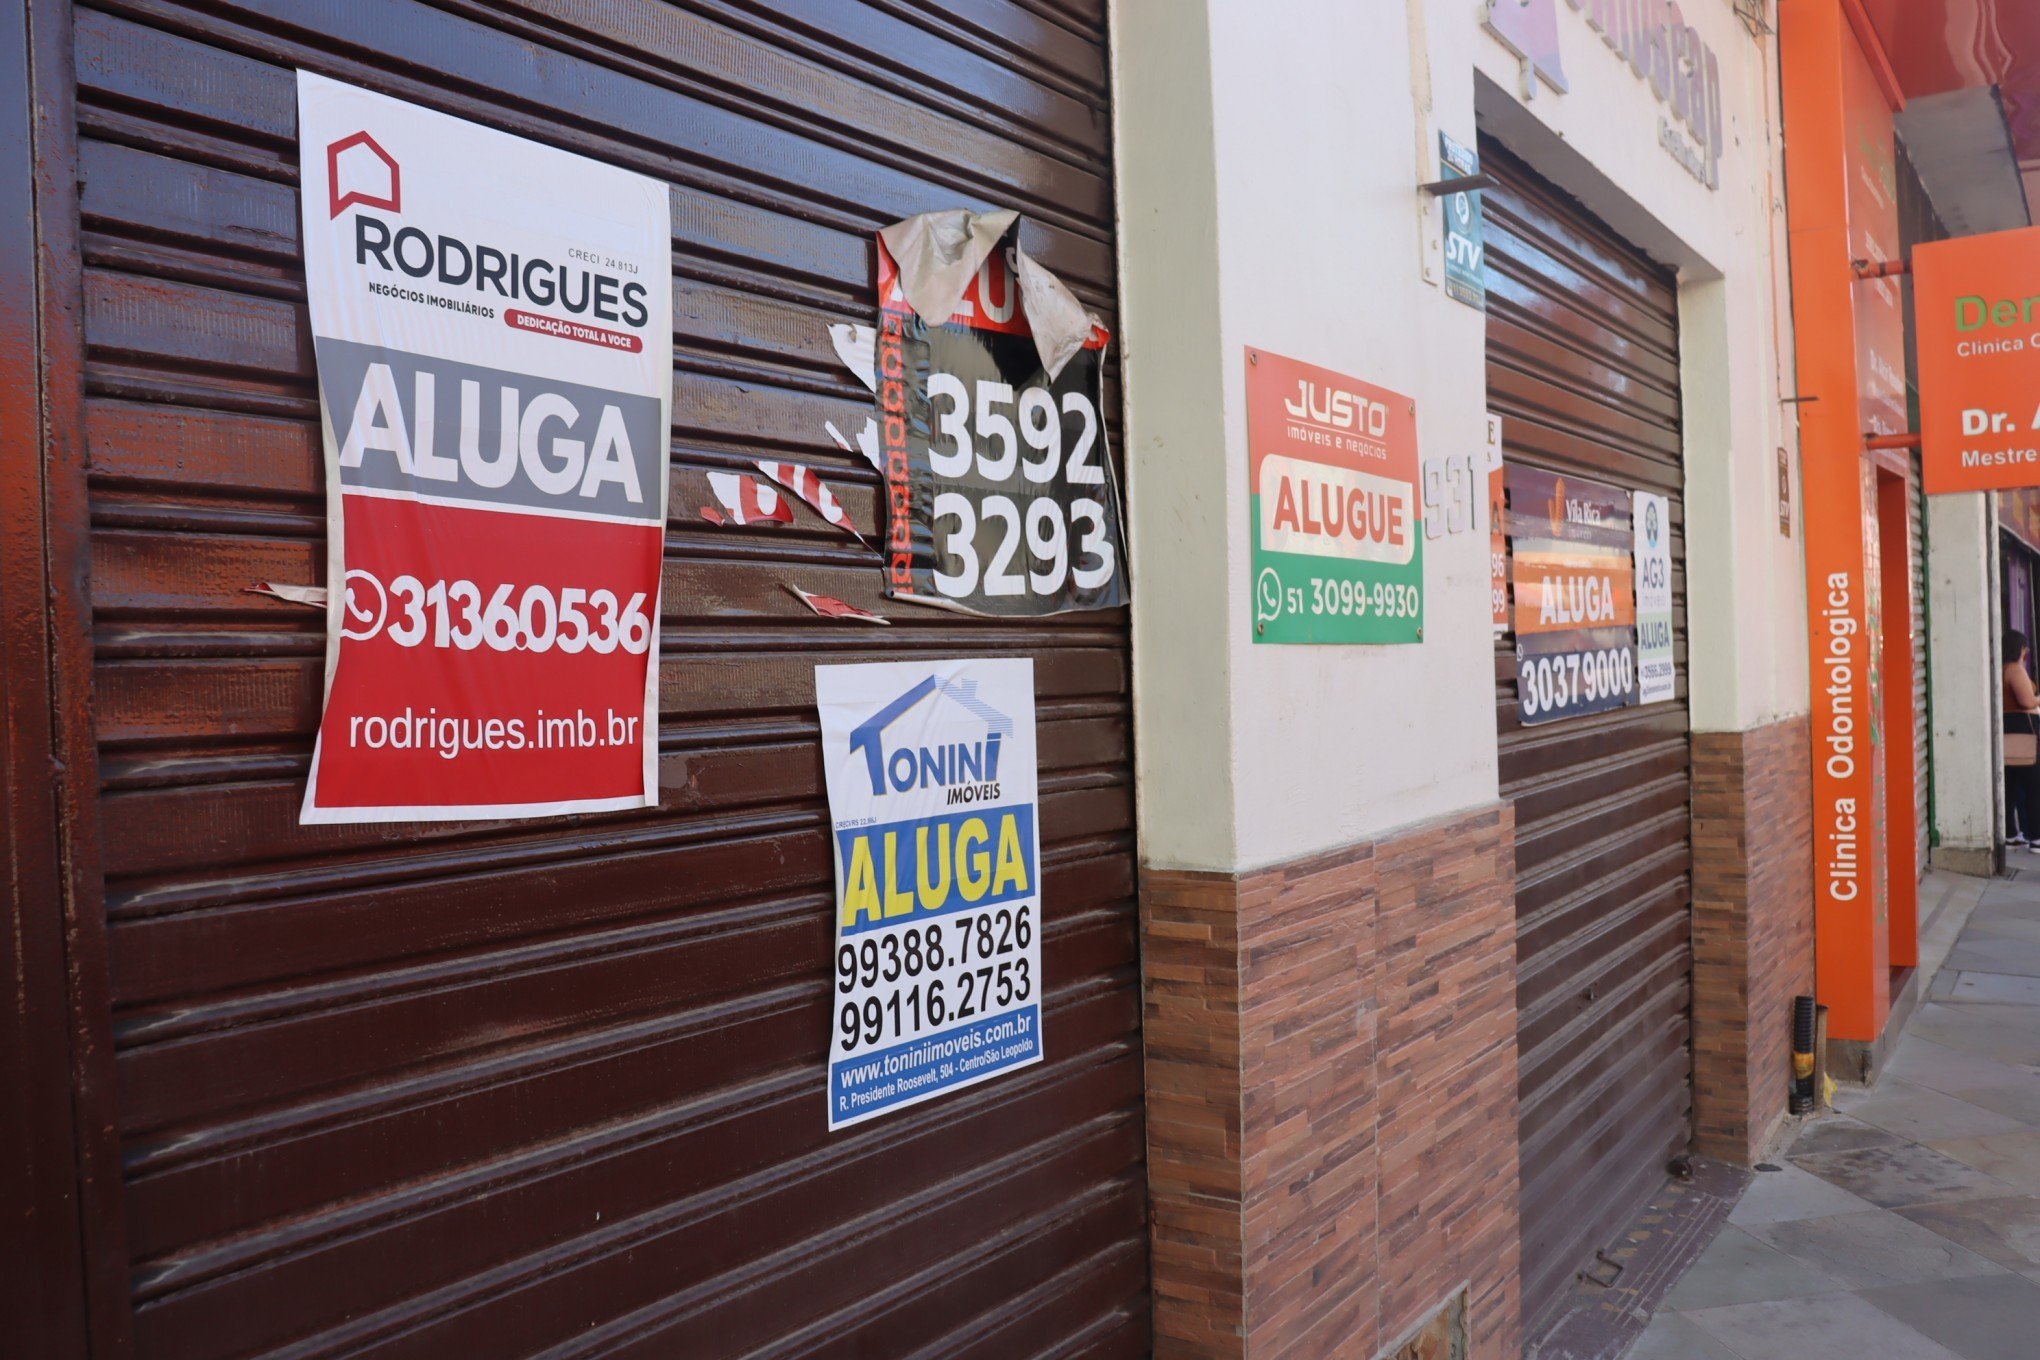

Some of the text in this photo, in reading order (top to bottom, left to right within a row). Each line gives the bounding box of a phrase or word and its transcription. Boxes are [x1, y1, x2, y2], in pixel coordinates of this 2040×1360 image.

[355, 213, 648, 328] RODRIGUES
[568, 248, 600, 264] CRECI
[1446, 230, 1481, 271] STV
[369, 281, 495, 319] NEGÓCIOS IMOBILIÁRIOS
[516, 313, 571, 336] DEDICAÇÃO
[572, 326, 599, 341] TOTAL
[600, 332, 607, 343] A
[1957, 336, 2024, 357] Clinica
[339, 362, 644, 504] ALUGA
[927, 372, 1105, 485] 3592
[1284, 379, 1386, 438] JUSTO
[1961, 408, 2016, 436] Dr.
[1287, 426, 1387, 460] imóveis e negócios
[1961, 448, 2038, 468] Mestre
[1273, 475, 1405, 546] ALUGUE
[1423, 455, 1477, 541] 931
[1565, 499, 1583, 524] Vila
[932, 492, 1115, 598] 3293
[1286, 578, 1419, 618] 51 3099-9930
[1642, 557, 1665, 589] AG3
[1540, 575, 1615, 625] ALUGA
[1640, 621, 1670, 650] ALUGA
[1521, 647, 1633, 716] 30379000
[350, 707, 638, 760] rodrigues.imb.br
[1822, 571, 1858, 902] Clinica Odontologica
[946, 781, 1001, 805] IMÓVEIS
[840, 813, 1028, 927] ALUGA
[838, 905, 1031, 994] 99388.7826
[840, 957, 1031, 1052] 99116.2753
[840, 1095, 849, 1111] R.
[852, 1083, 895, 1109] Presidente
[897, 1069, 938, 1093] Roosevelt,
[940, 1063, 954, 1078] 504
[1001, 1039, 1033, 1059] Leopoldo
[841, 1014, 1031, 1089] www.toniniimoveis.com.br
